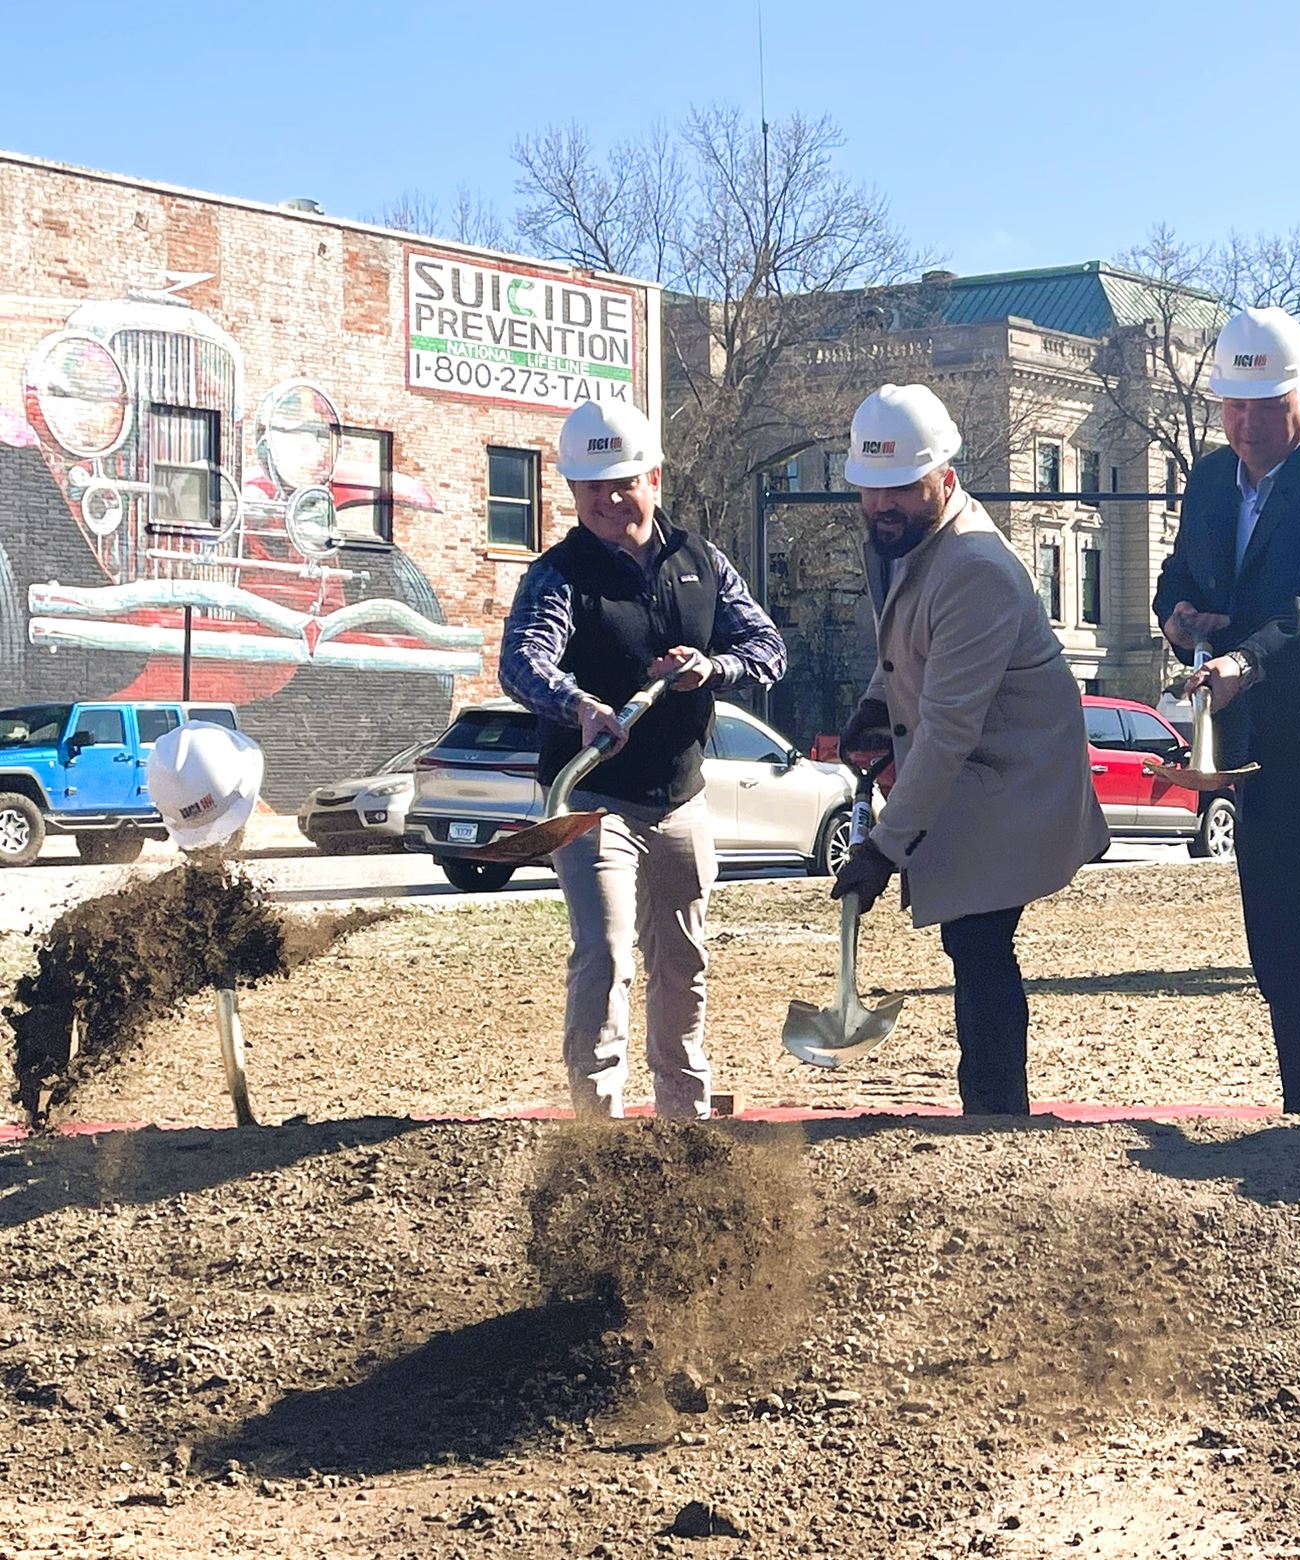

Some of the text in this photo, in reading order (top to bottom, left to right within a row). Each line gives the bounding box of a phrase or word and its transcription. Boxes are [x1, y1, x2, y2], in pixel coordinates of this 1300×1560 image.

[415, 261, 627, 333] SUICIDE
[415, 302, 628, 365] PREVENTION
[446, 340, 591, 376] NATIONAL LIFELINE
